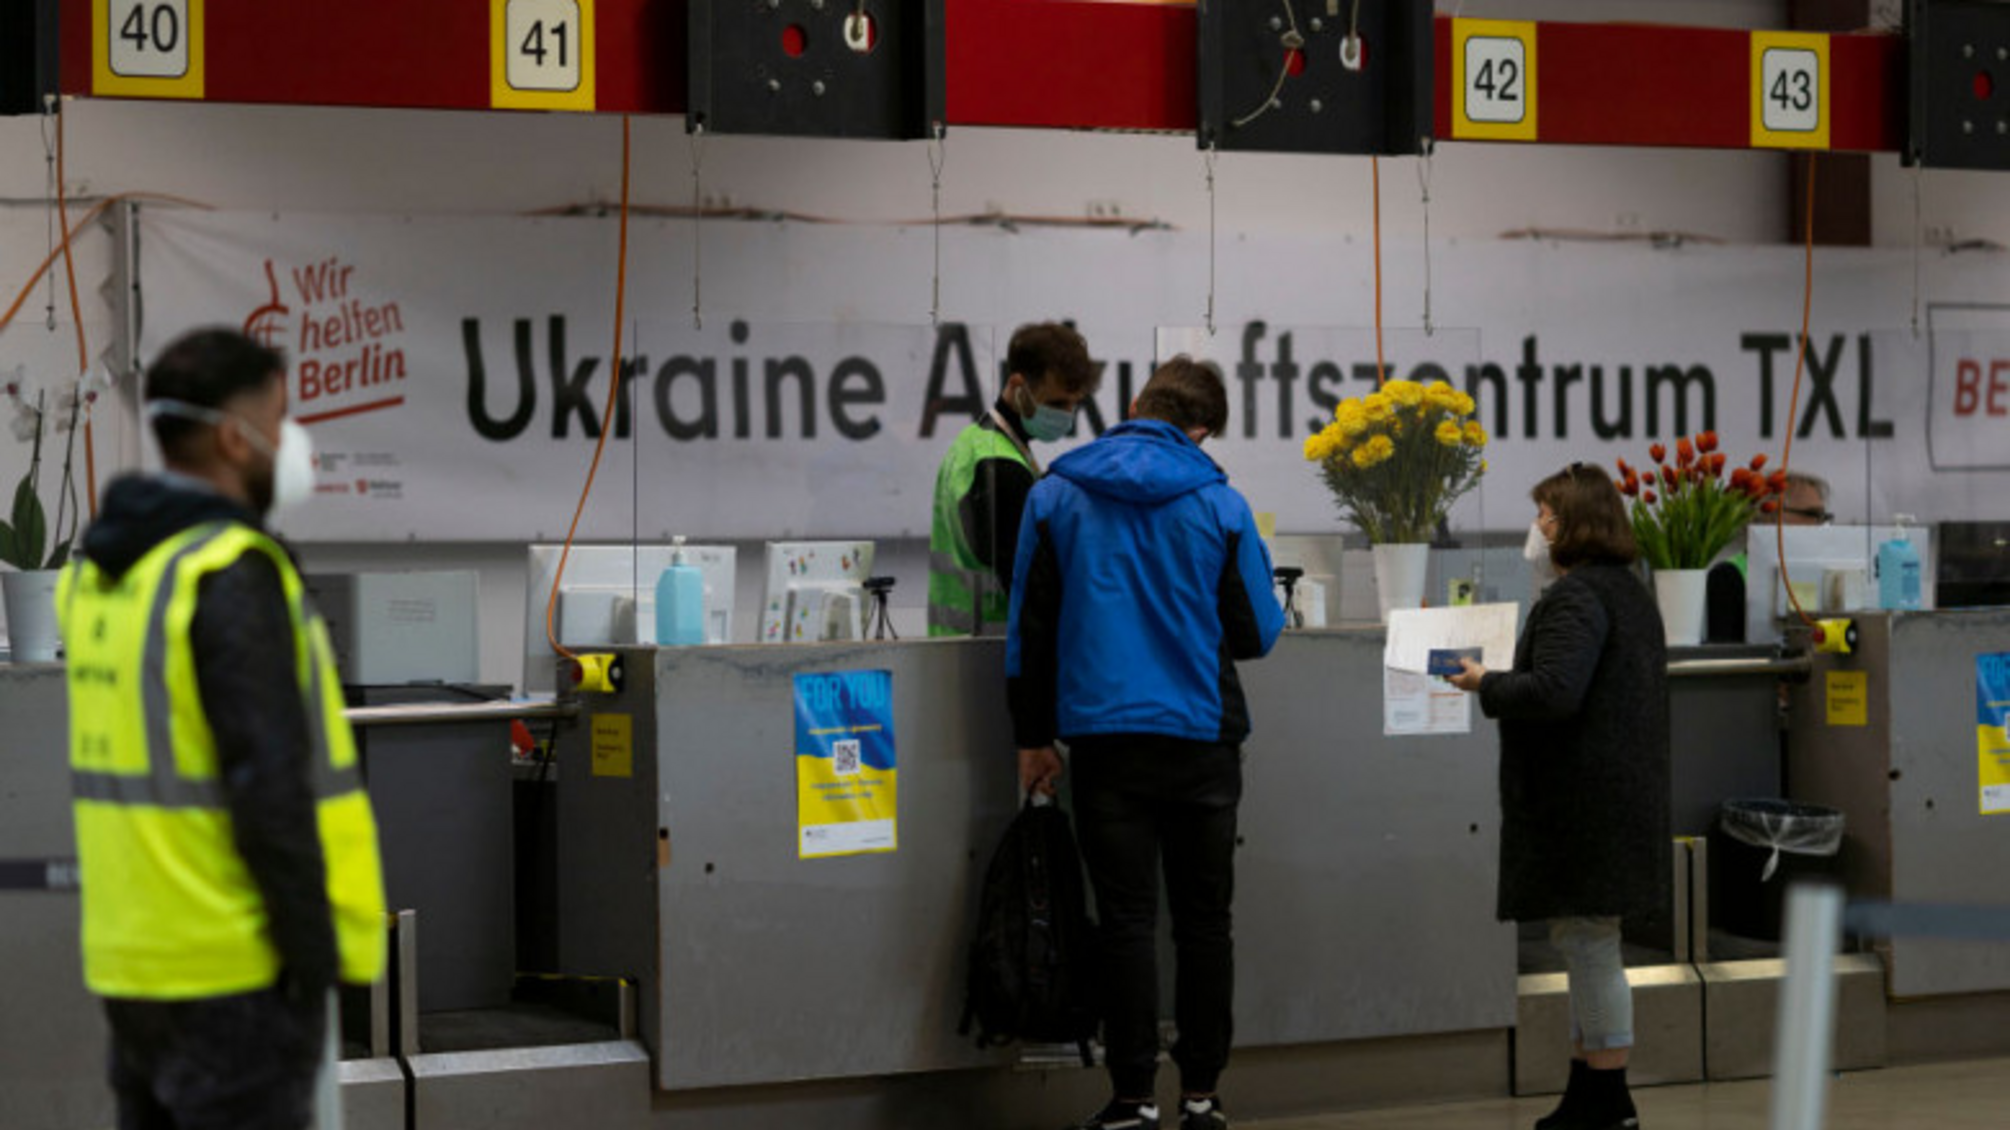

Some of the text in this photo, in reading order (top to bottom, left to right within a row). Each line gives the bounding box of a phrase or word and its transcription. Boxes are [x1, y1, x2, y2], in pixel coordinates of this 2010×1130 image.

[120, 3, 178, 53] 40
[521, 19, 566, 67] 41
[1474, 58, 1518, 100] 42
[1770, 69, 1811, 111] 43
[293, 256, 354, 304] Wir
[299, 299, 403, 352] helfen
[299, 342, 405, 400] Berlin
[462, 314, 886, 441] Ukraine
[1741, 333, 1894, 439] TXL
[800, 673, 886, 712] FOR YOU
